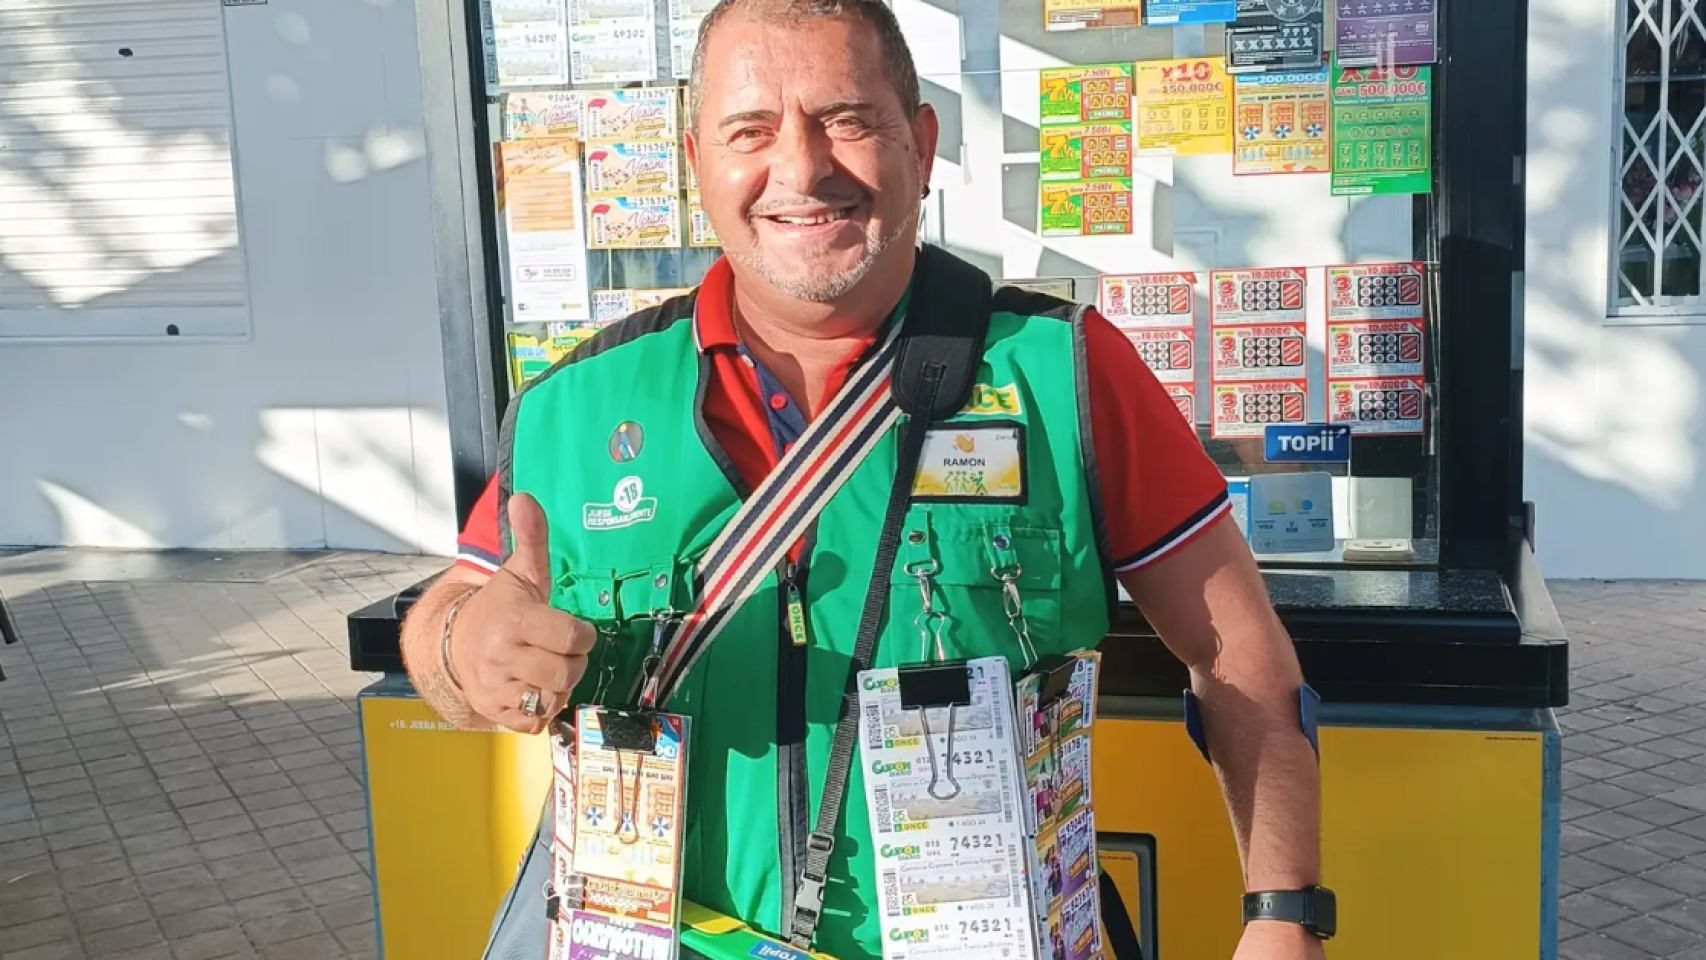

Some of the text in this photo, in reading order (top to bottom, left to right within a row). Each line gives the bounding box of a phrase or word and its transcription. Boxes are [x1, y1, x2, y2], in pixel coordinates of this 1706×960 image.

[943, 457, 986, 468] RAMON
[1258, 523, 1275, 531] VISA
[1311, 520, 1327, 529] VISA
[791, 604, 804, 641] ONCE
[409, 720, 436, 730] JUEGA
[903, 822, 928, 831] ONCE
[950, 833, 1003, 850] 74321
[912, 906, 937, 914] ONCE
[958, 918, 1012, 934] 74321
